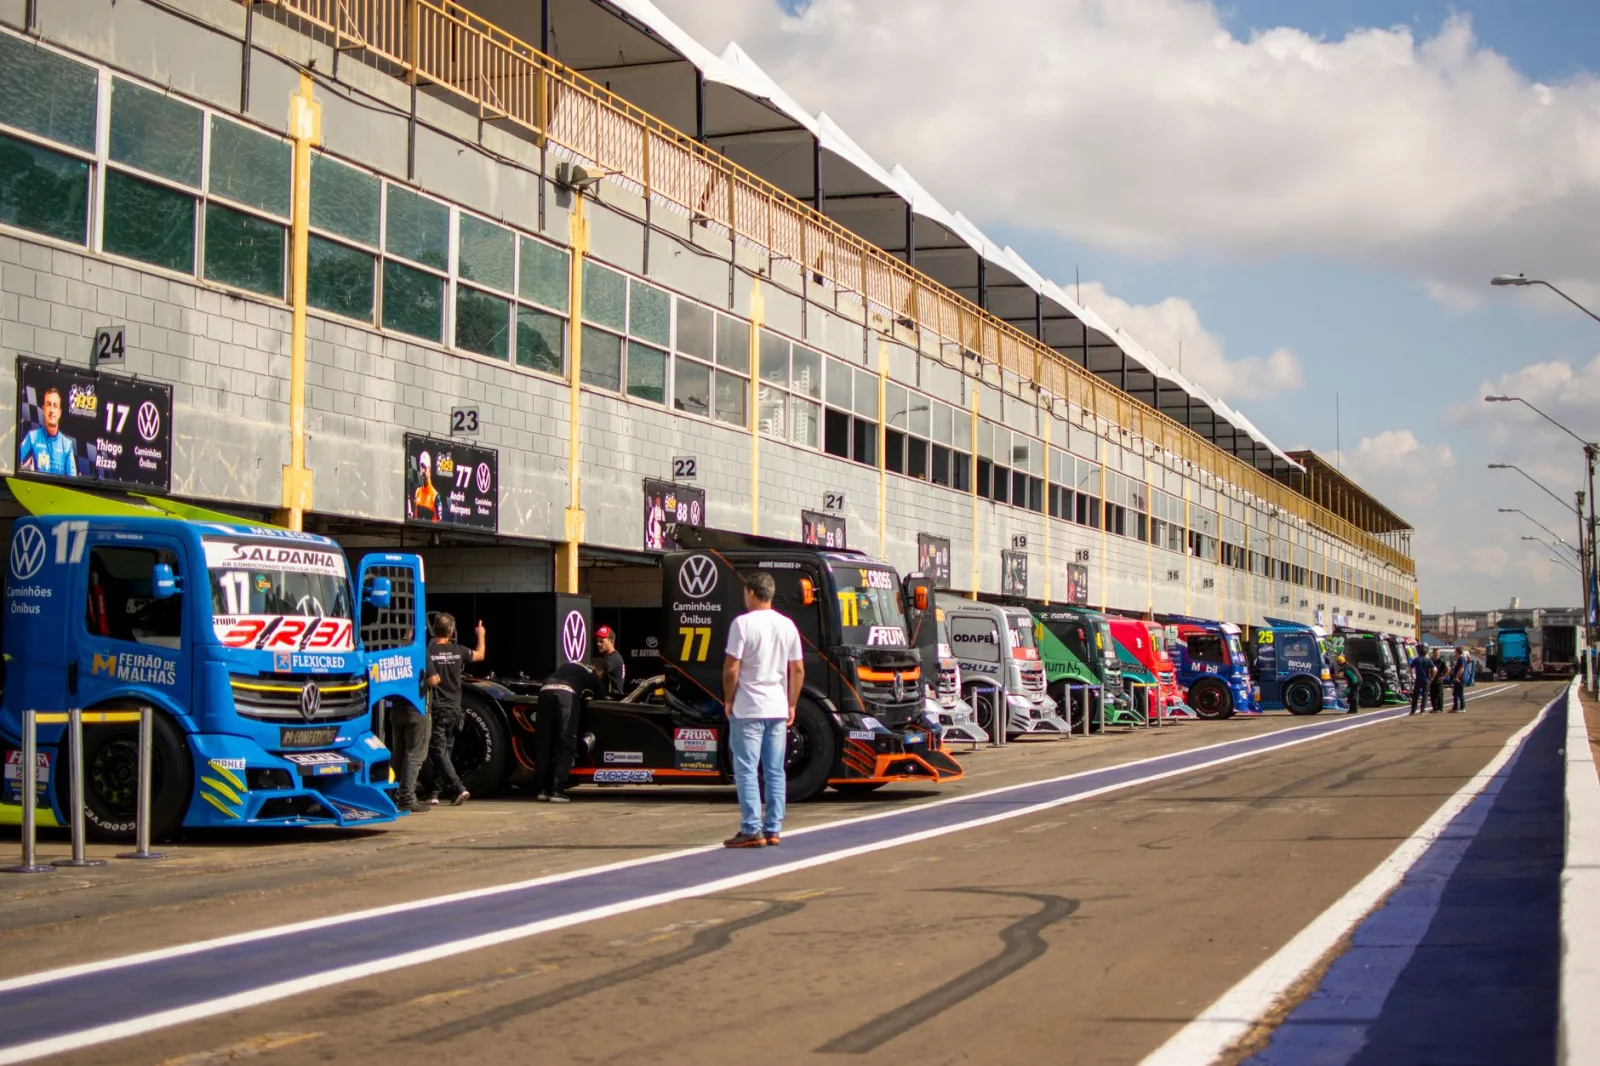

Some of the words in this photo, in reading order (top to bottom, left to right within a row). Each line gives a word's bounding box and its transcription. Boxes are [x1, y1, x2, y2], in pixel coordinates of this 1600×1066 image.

[99, 331, 124, 358] 24
[105, 402, 130, 433] 17
[453, 411, 478, 431] 23
[96, 438, 122, 454] Thiago
[134, 446, 162, 459] Caminhões
[96, 455, 117, 469] Rizzo
[139, 458, 157, 469] Ônibus
[675, 460, 696, 476] 22
[456, 464, 472, 488] 77
[826, 494, 844, 510] 21
[677, 502, 688, 521] 88
[250, 527, 313, 541] METEOR
[665, 522, 676, 533] 77
[51, 520, 89, 564] 17
[1012, 536, 1026, 547] 19
[223, 544, 335, 568] SALDANHA
[1077, 550, 1089, 561] 18
[1168, 571, 1179, 580] 16
[1204, 579, 1214, 588] 15
[7, 585, 52, 597] Caminhões
[219, 571, 250, 615] 17
[10, 600, 40, 614] Ônibus
[673, 602, 721, 612] Caminhões
[680, 612, 712, 625] Ônibus
[867, 626, 907, 646] FRUM
[953, 634, 990, 643] ODAPE
[1258, 630, 1274, 644] 25
[679, 627, 711, 661] 77
[119, 652, 161, 669] FEIRÃO
[163, 660, 176, 671] DE
[292, 655, 345, 668] FLEXICRED
[378, 654, 403, 669] FEIRÃO
[404, 656, 411, 666] DE
[1191, 662, 1218, 674] Mobil
[1288, 660, 1312, 669] BICAR
[117, 665, 176, 685] MALHAS
[379, 665, 413, 682] MALHAS
[466, 708, 492, 762] GOODYEAR
[676, 729, 715, 740] FRUM
[680, 761, 713, 769] GOODYEAR
[594, 768, 656, 782] EMBREAGEX
